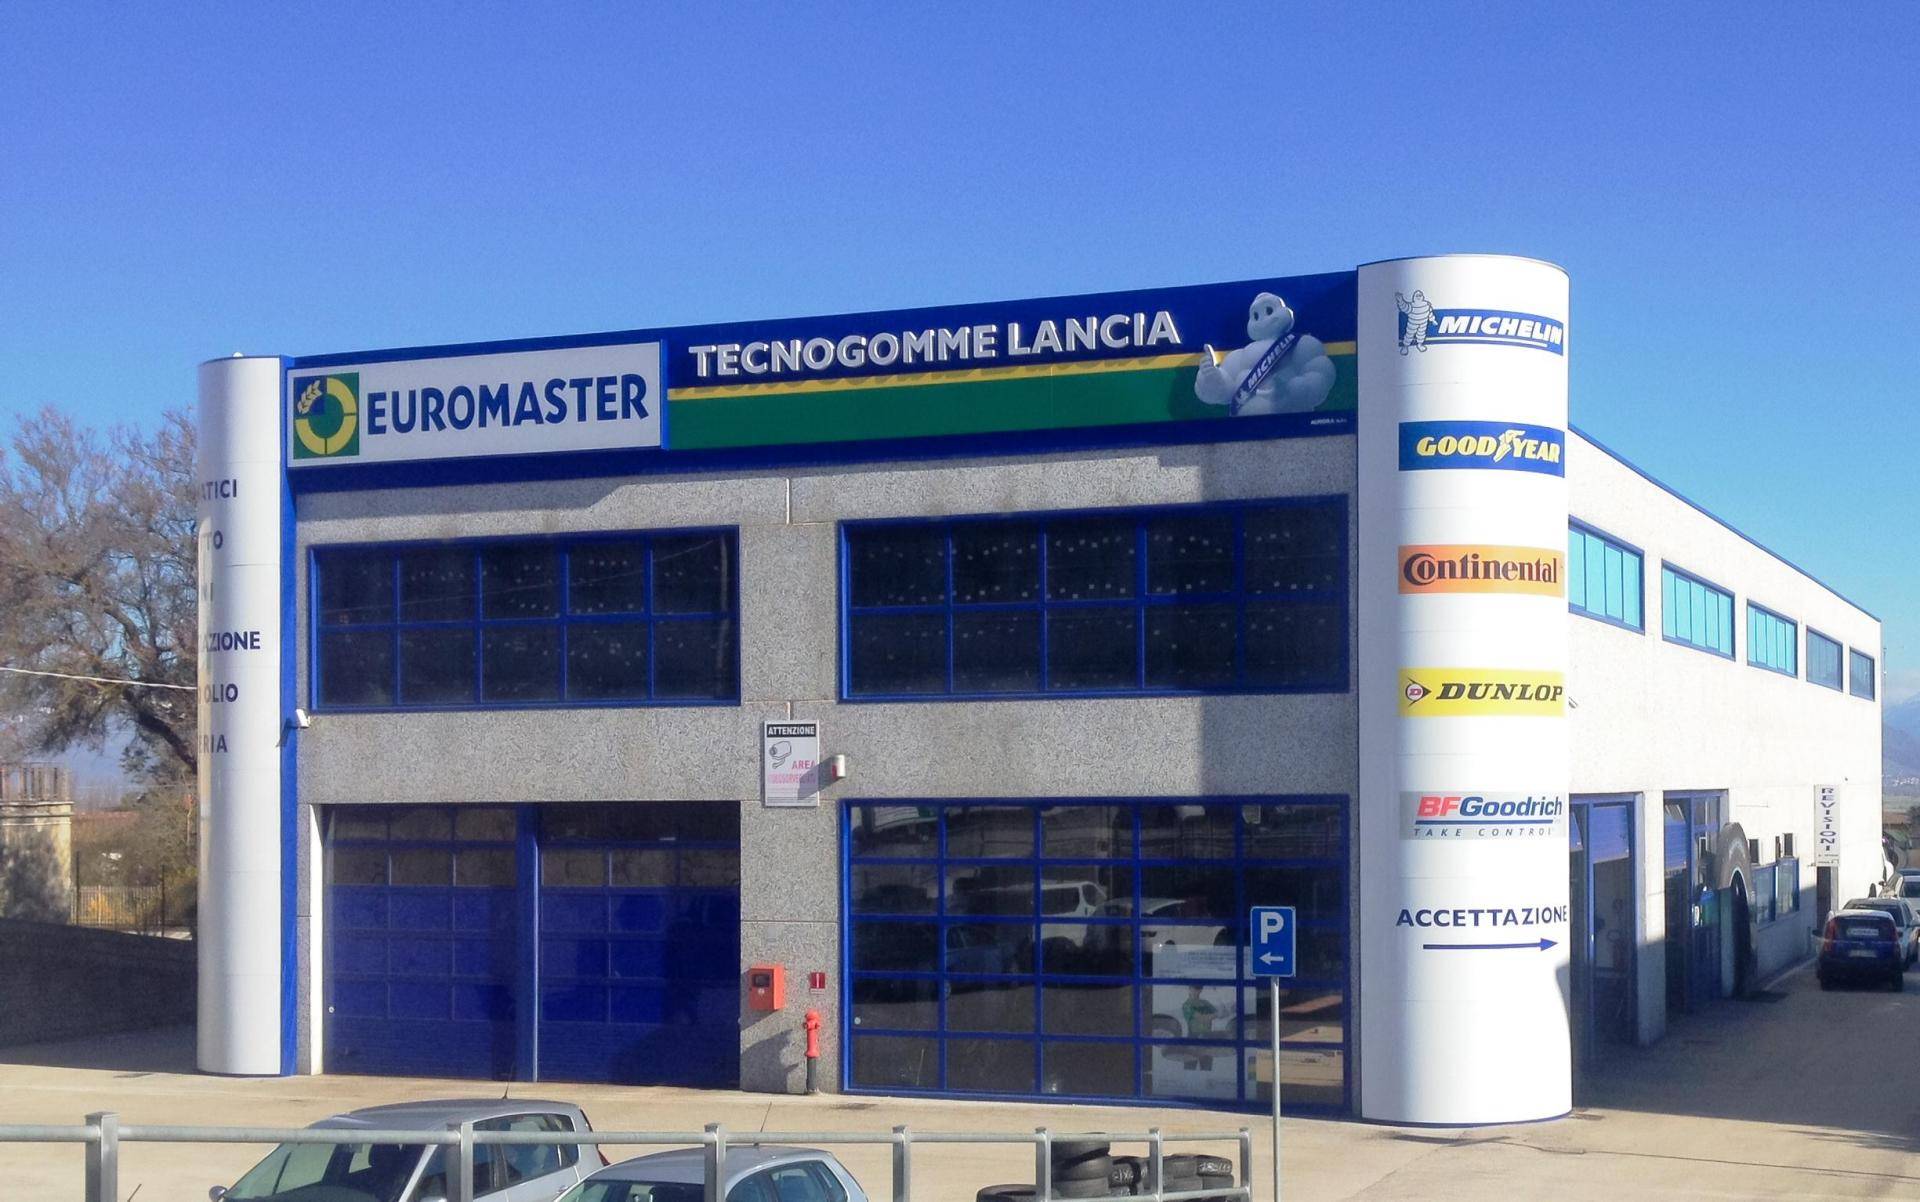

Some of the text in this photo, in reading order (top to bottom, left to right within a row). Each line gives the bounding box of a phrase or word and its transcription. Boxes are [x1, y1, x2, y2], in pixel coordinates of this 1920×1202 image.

[688, 310, 1182, 378] TECNOGOMME LANCIA
[1438, 315, 1563, 344] MICHELIN
[1247, 333, 1296, 389] MICHELIN
[367, 373, 649, 436] EUROMASTER
[1403, 552, 1558, 586] Continental
[1435, 682, 1563, 702] DUNLOP
[768, 726, 815, 736] ATTENZIONE
[1416, 796, 1562, 817] BFGoodrich
[1820, 787, 1837, 851] REVISIONI
[1414, 828, 1462, 837] TAKE
[1260, 911, 1284, 944] P
[1396, 905, 1567, 928] ACCETTAZIONE
